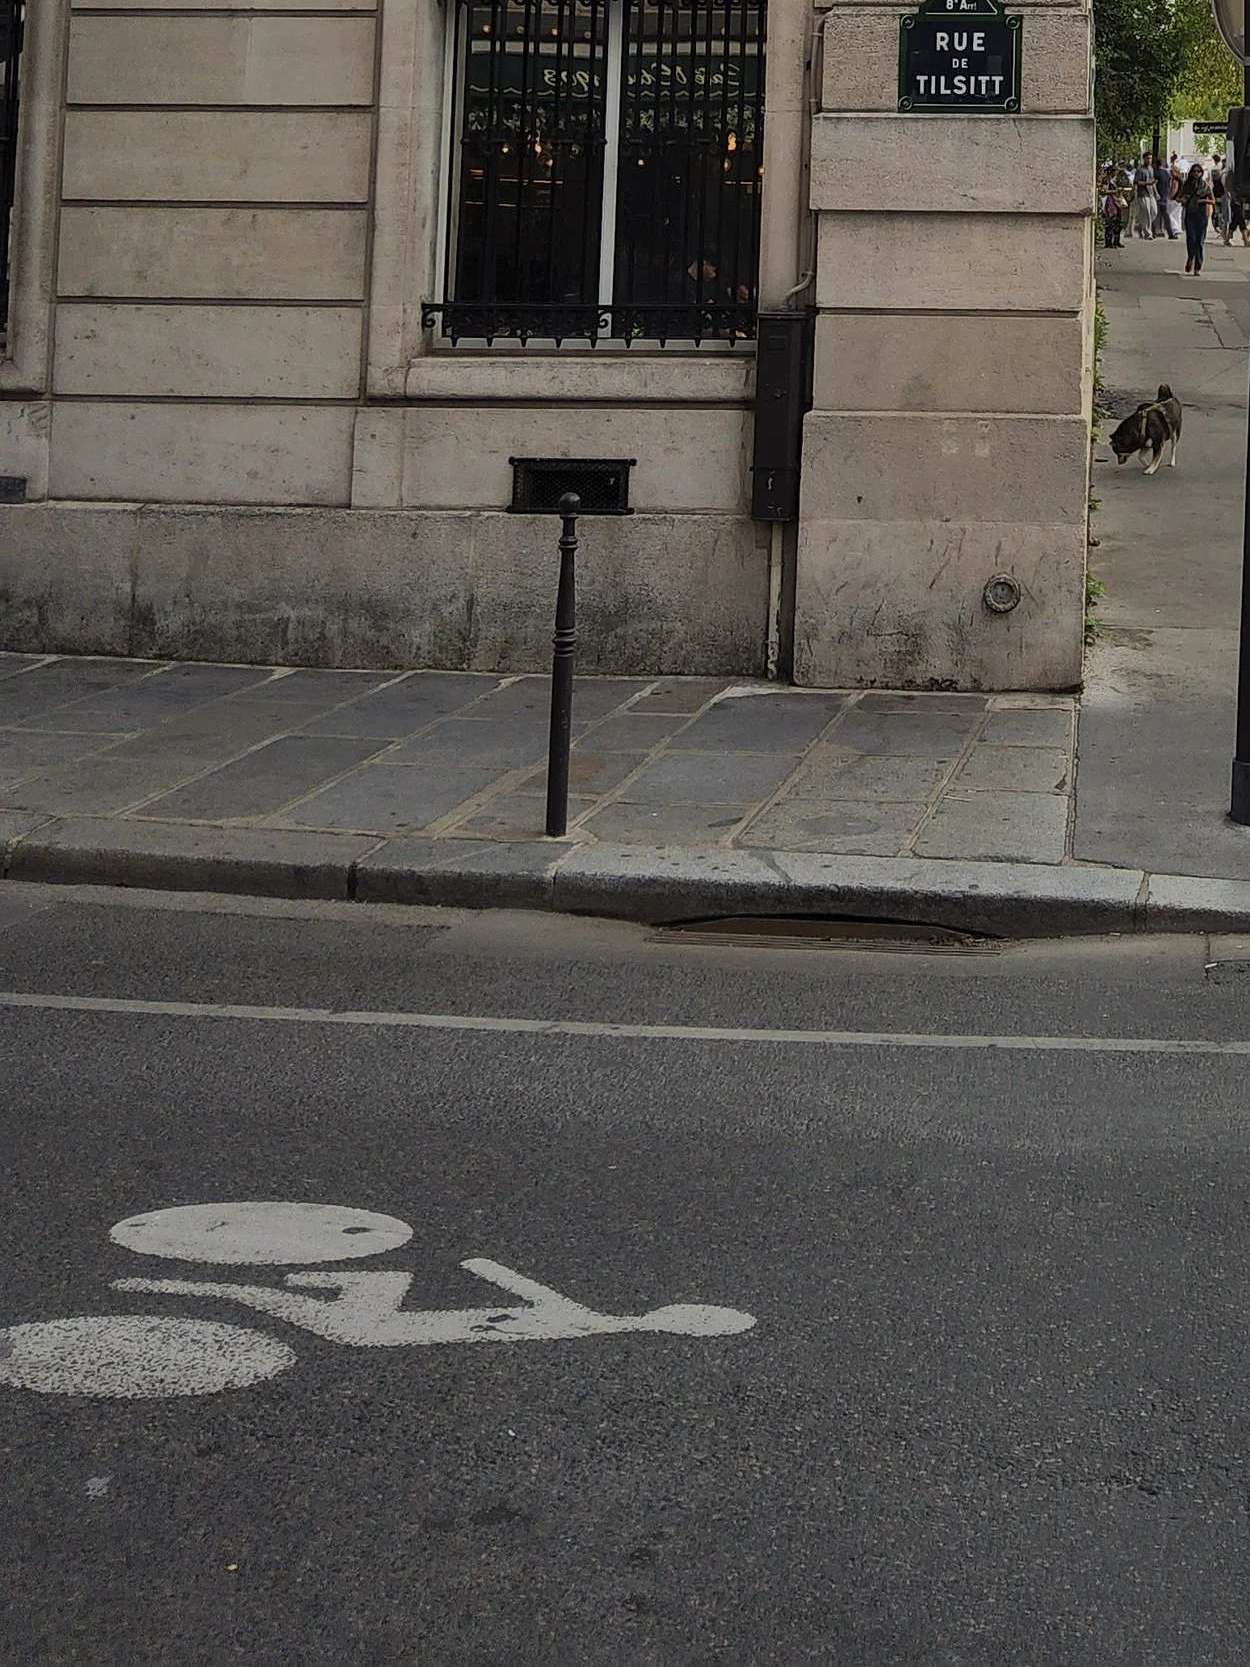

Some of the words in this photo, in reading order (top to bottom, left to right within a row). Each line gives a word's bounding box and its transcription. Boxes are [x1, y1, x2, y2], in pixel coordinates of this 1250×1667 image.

[935, 32, 986, 52] RUE
[952, 58, 968, 69] DE
[916, 75, 1004, 95] TILSITT
